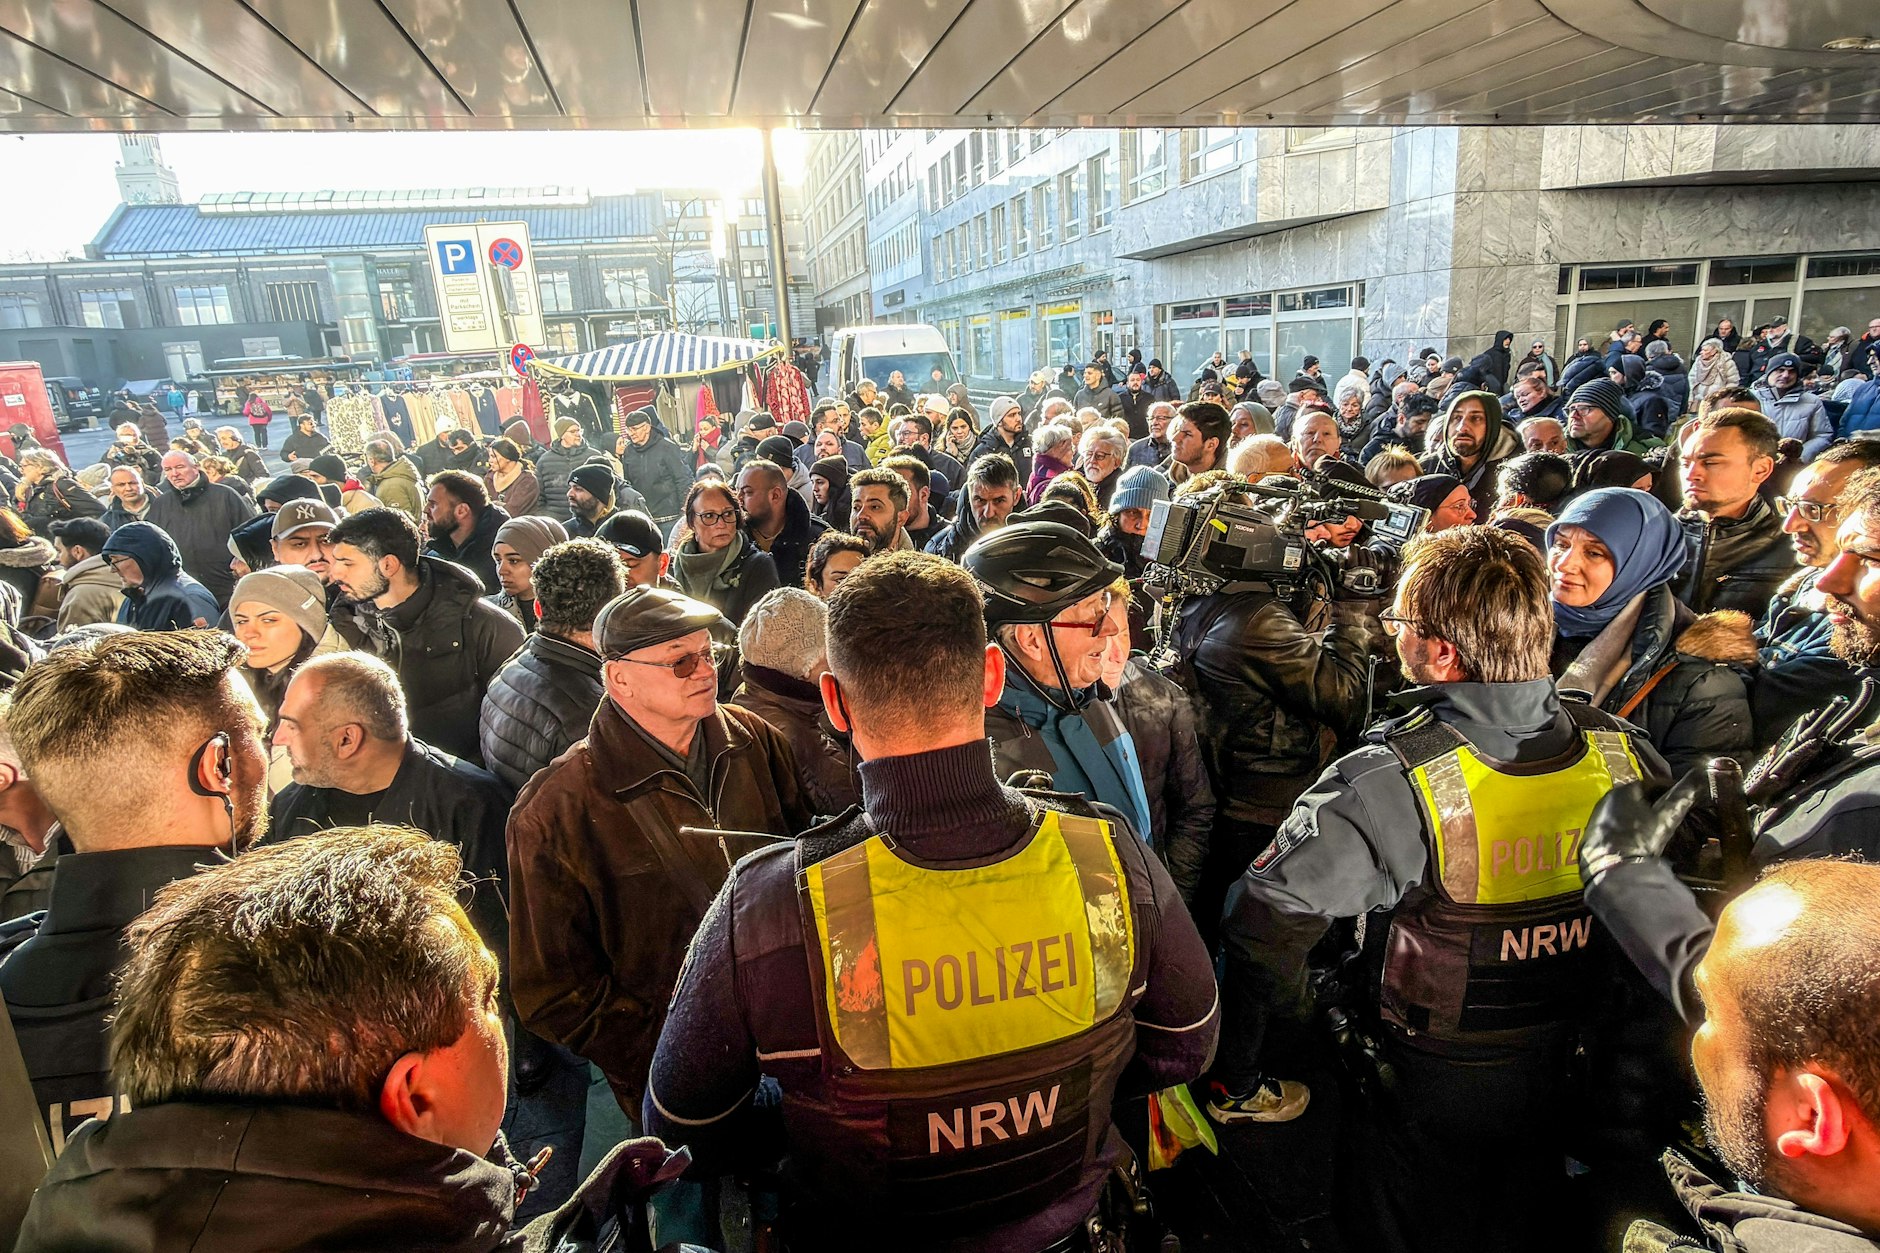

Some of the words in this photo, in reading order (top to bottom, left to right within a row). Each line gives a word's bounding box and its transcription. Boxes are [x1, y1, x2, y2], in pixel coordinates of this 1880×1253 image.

[444, 243, 466, 271] P
[1500, 914, 1593, 961] NRW
[901, 931, 1078, 1017] POLIZEI
[927, 1084, 1061, 1154] NRW
